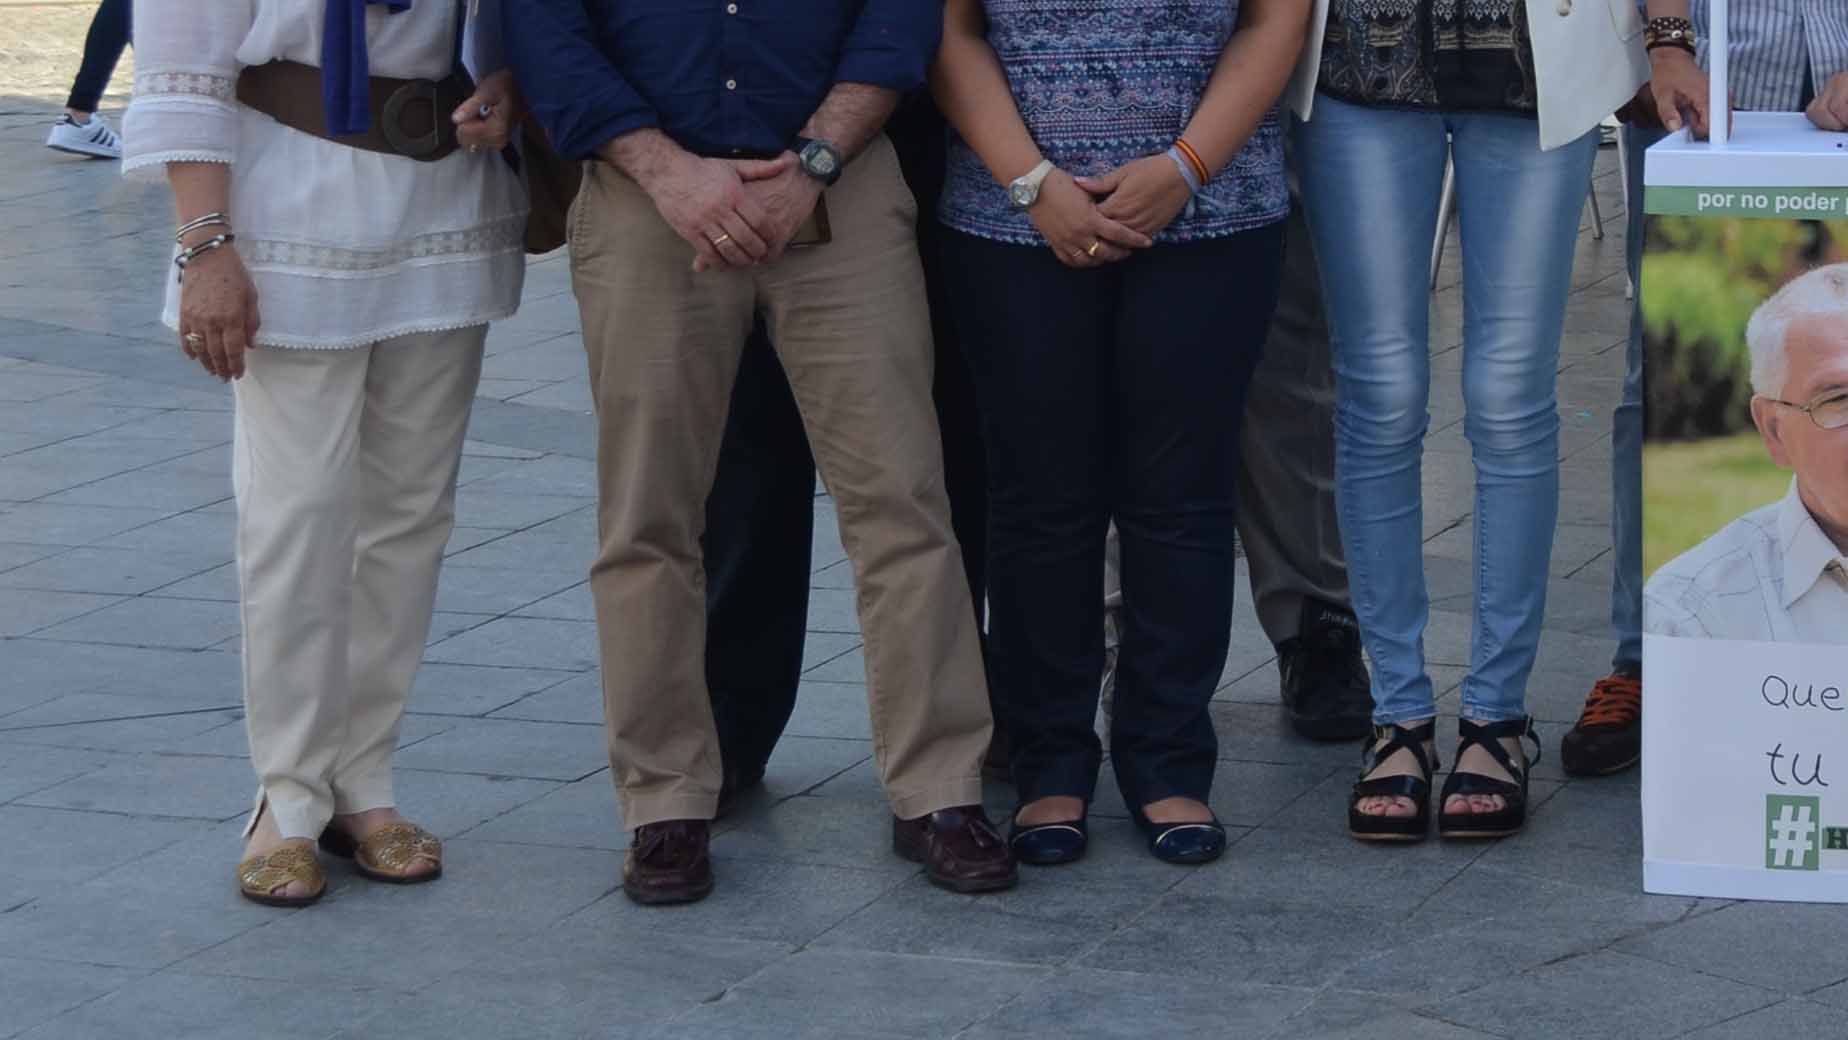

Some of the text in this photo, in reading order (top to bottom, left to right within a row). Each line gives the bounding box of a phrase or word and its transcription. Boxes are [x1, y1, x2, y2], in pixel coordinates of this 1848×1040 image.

[1697, 192, 1735, 211] por
[1741, 193, 1768, 209] no
[1775, 192, 1839, 213] poder
[1761, 675, 1845, 711] Que
[1766, 743, 1829, 787] tu
